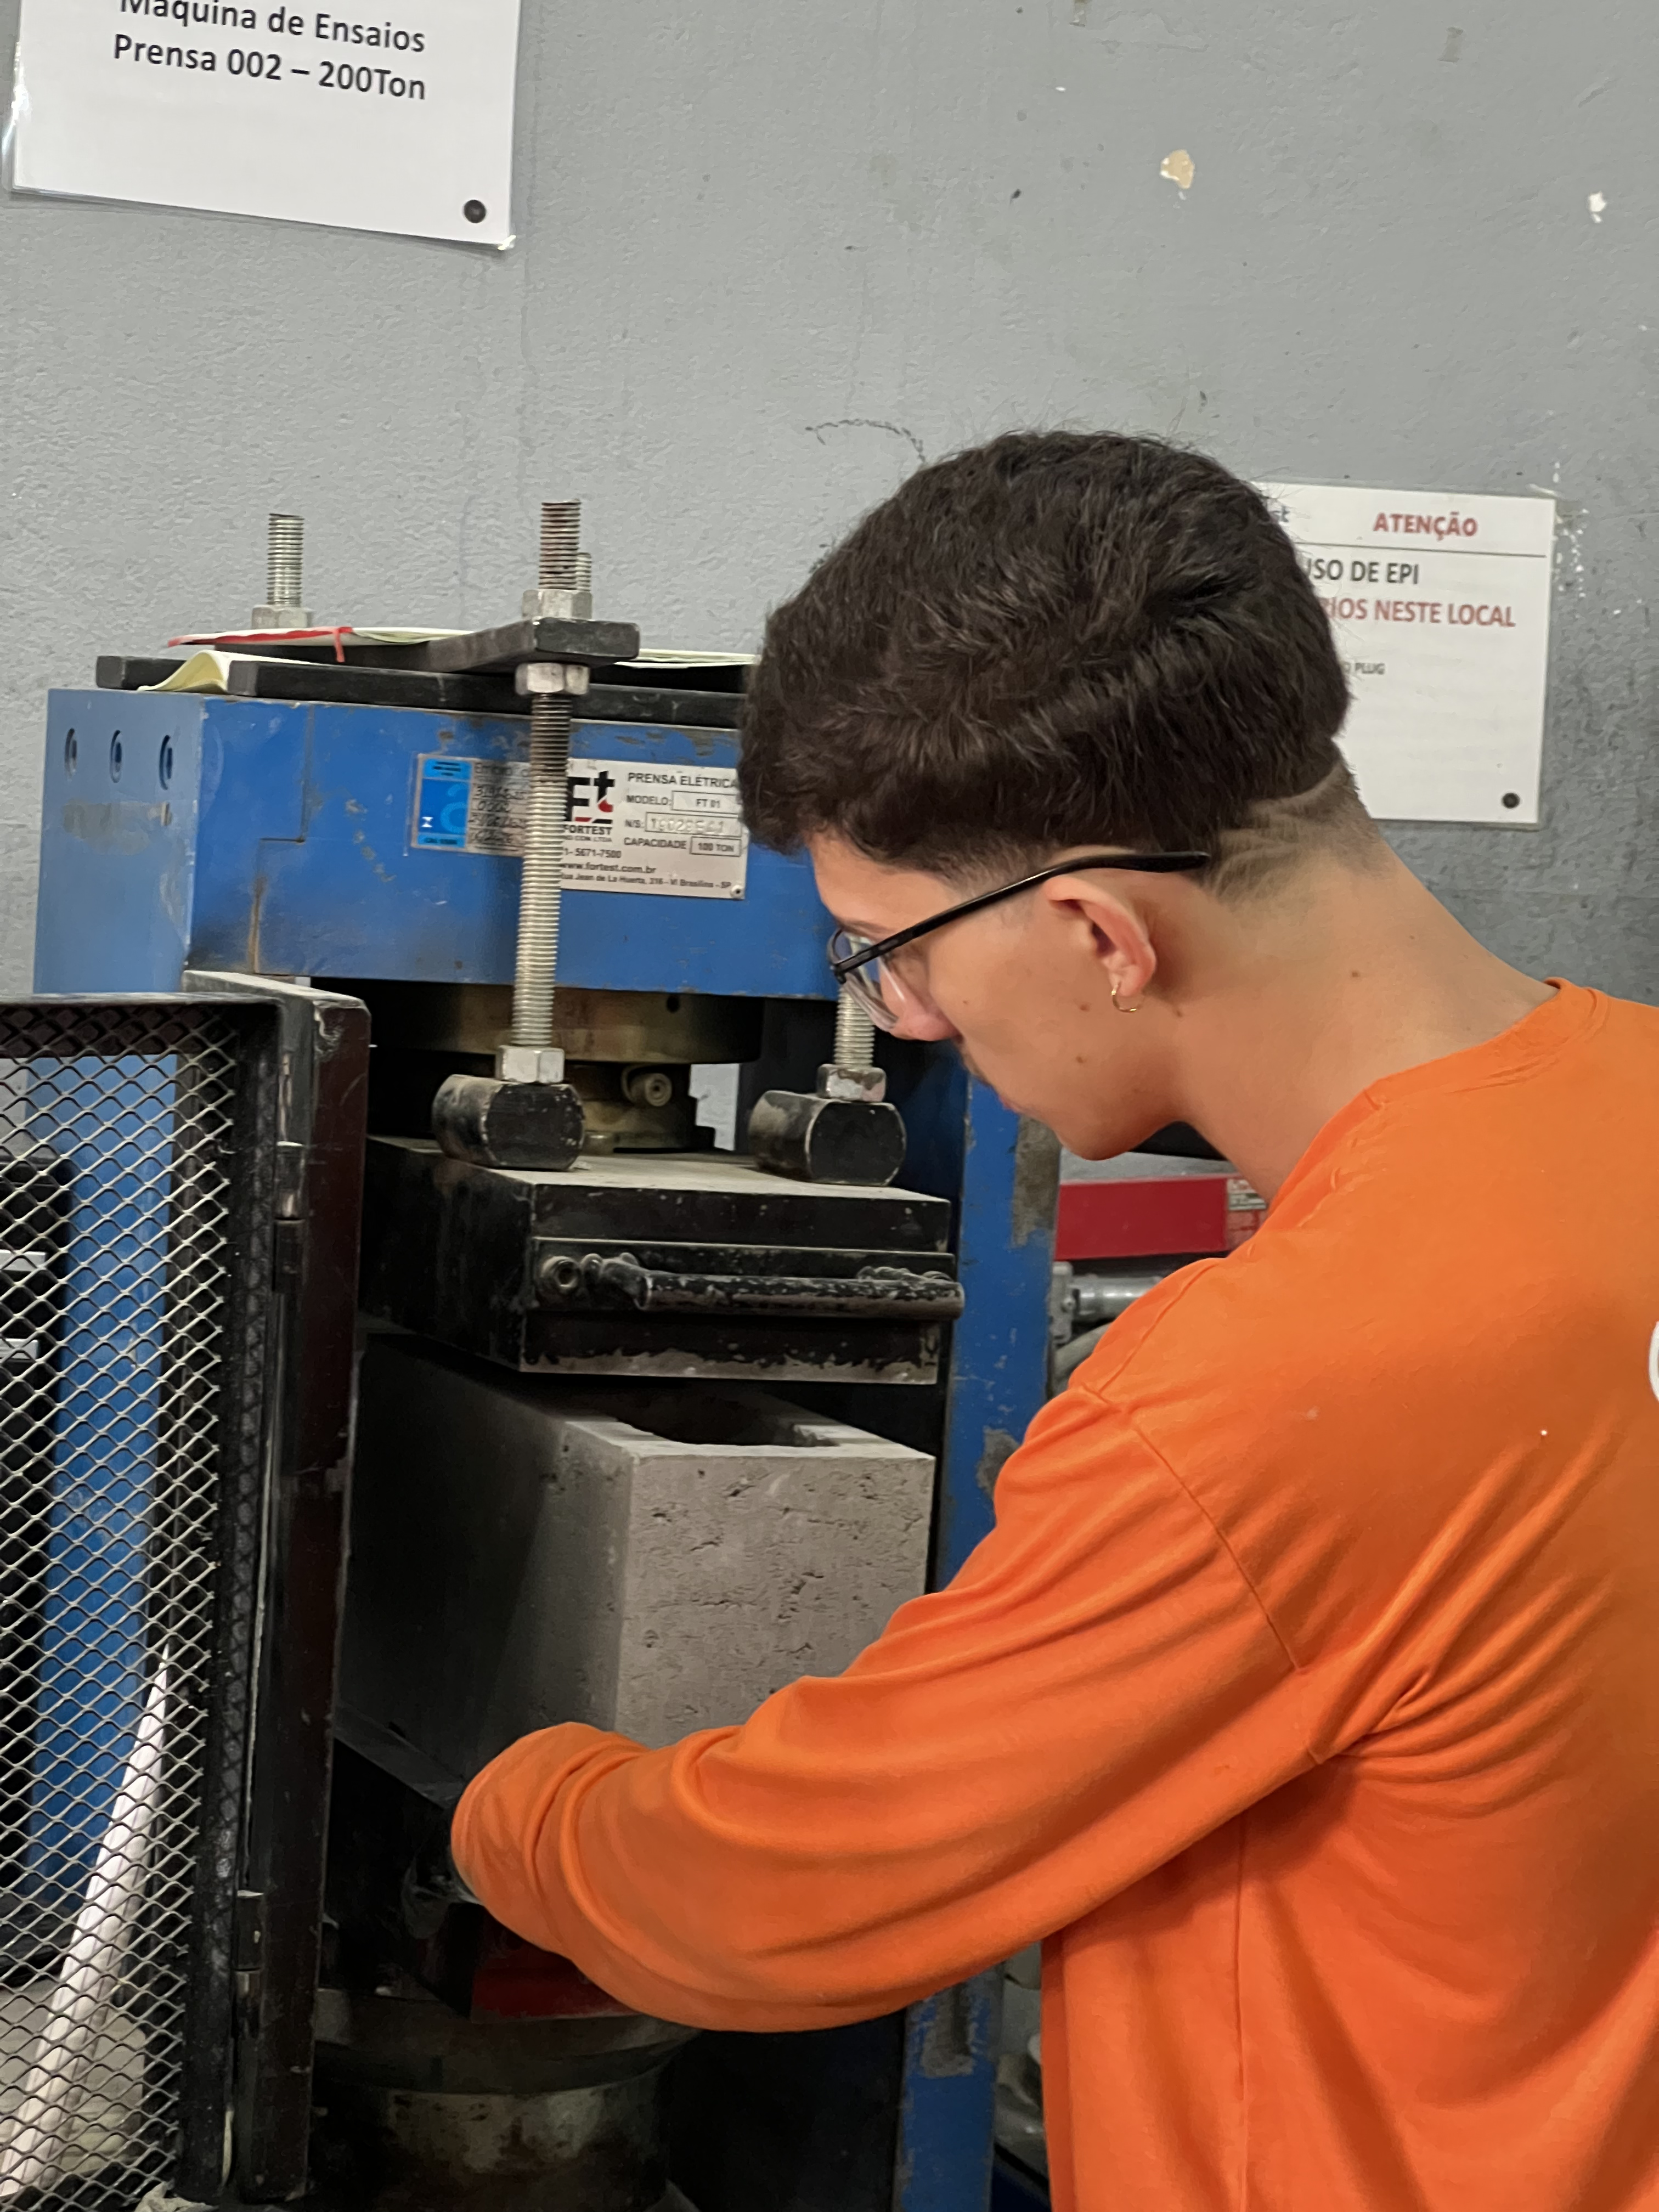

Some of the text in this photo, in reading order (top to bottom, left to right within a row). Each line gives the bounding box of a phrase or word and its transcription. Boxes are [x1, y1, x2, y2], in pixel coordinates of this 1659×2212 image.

[268, 6, 304, 35] de
[314, 13, 425, 52] Ensaios
[114, 33, 216, 71] Prensa
[227, 49, 281, 80] 002
[318, 61, 425, 99] 200Ton
[1373, 511, 1479, 541] ATENÇÃO
[1351, 561, 1379, 582] DE
[1386, 562, 1419, 585] EPI
[1374, 599, 1443, 623] NESTE
[1448, 603, 1516, 628] LOCAL
[1355, 662, 1385, 675] PLUG
[627, 772, 677, 785] PRENSA
[625, 794, 672, 806] MODELO:
[696, 798, 707, 807] FT
[623, 837, 687, 850] CAPACIDADE
